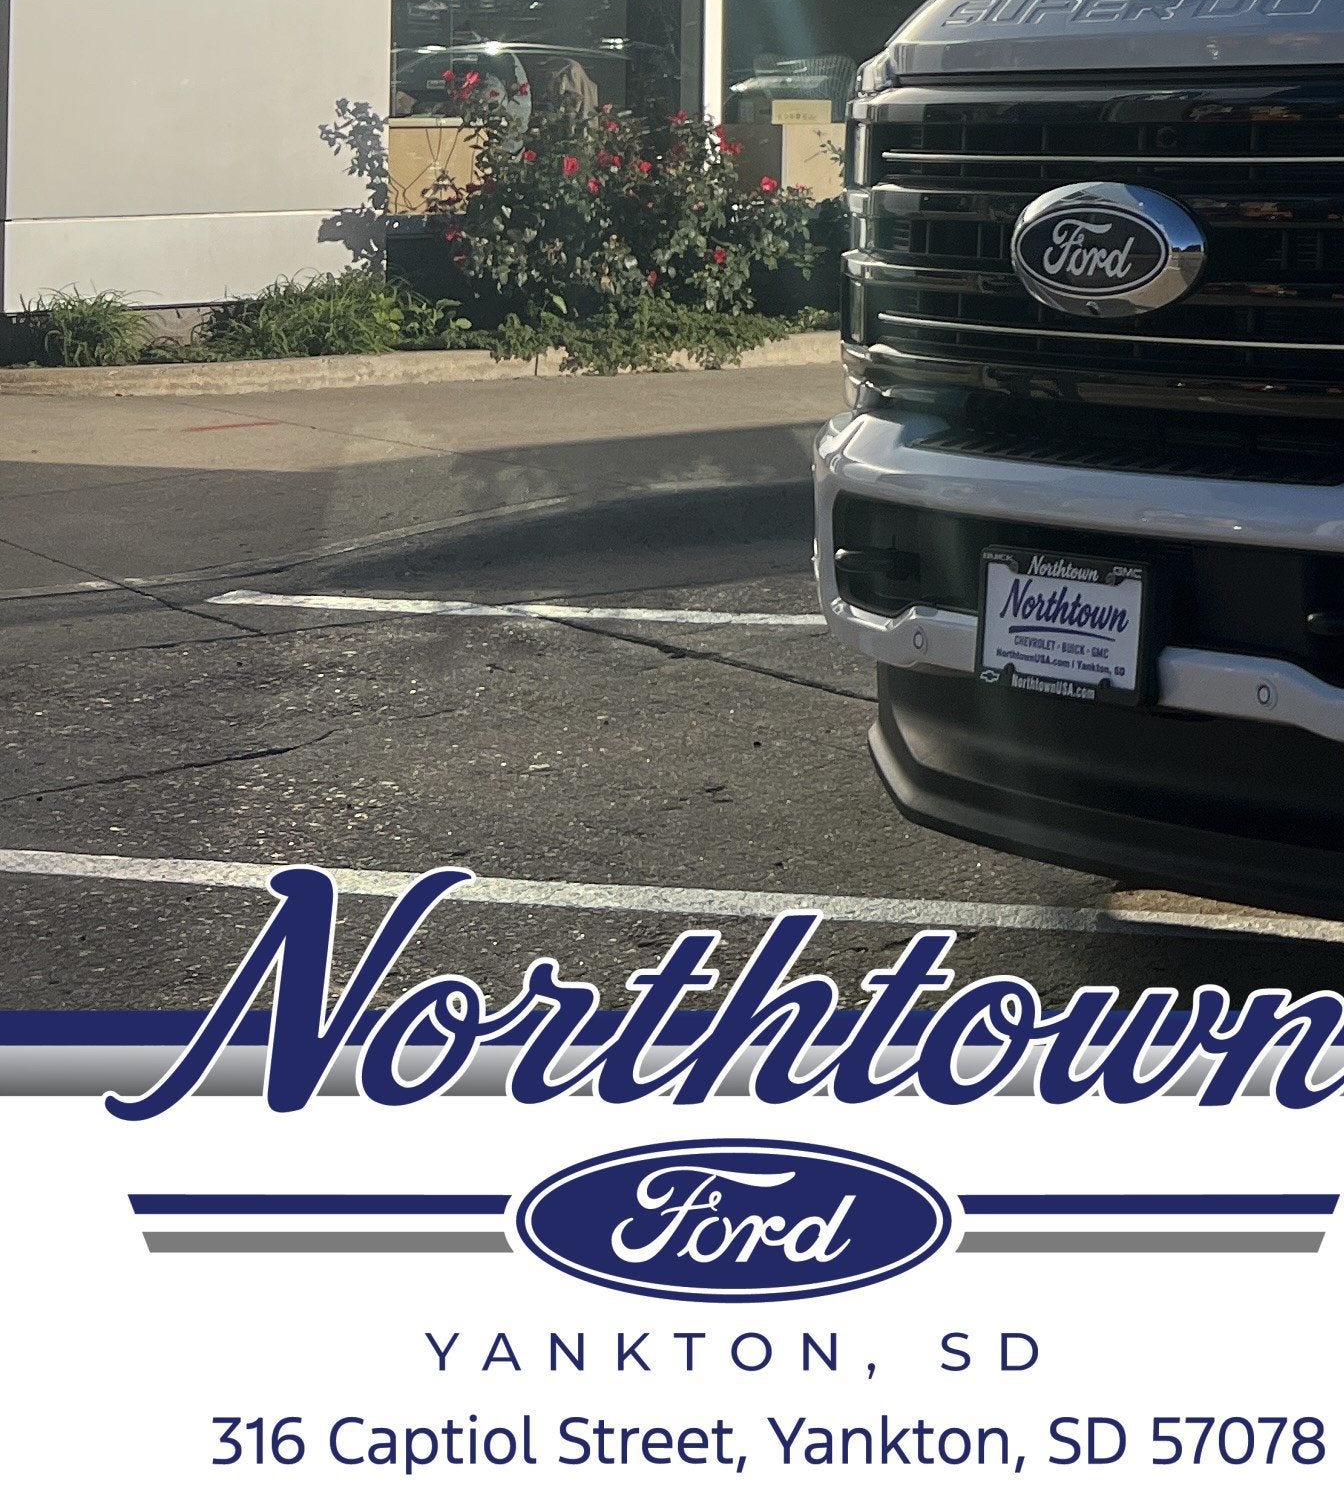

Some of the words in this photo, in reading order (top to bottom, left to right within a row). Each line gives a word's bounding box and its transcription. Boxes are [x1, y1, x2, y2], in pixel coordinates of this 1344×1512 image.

[1042, 217, 1137, 279] Ford
[1027, 555, 1099, 581] Northtown
[1000, 578, 1130, 633] Northtown
[996, 648, 1070, 668] NorthtownUSA.com
[1014, 635, 1056, 650] CHEVROLET
[1062, 641, 1085, 655] BUICK
[1091, 646, 1109, 659] GMC
[1011, 673, 1096, 700] NorthtownUSA.com
